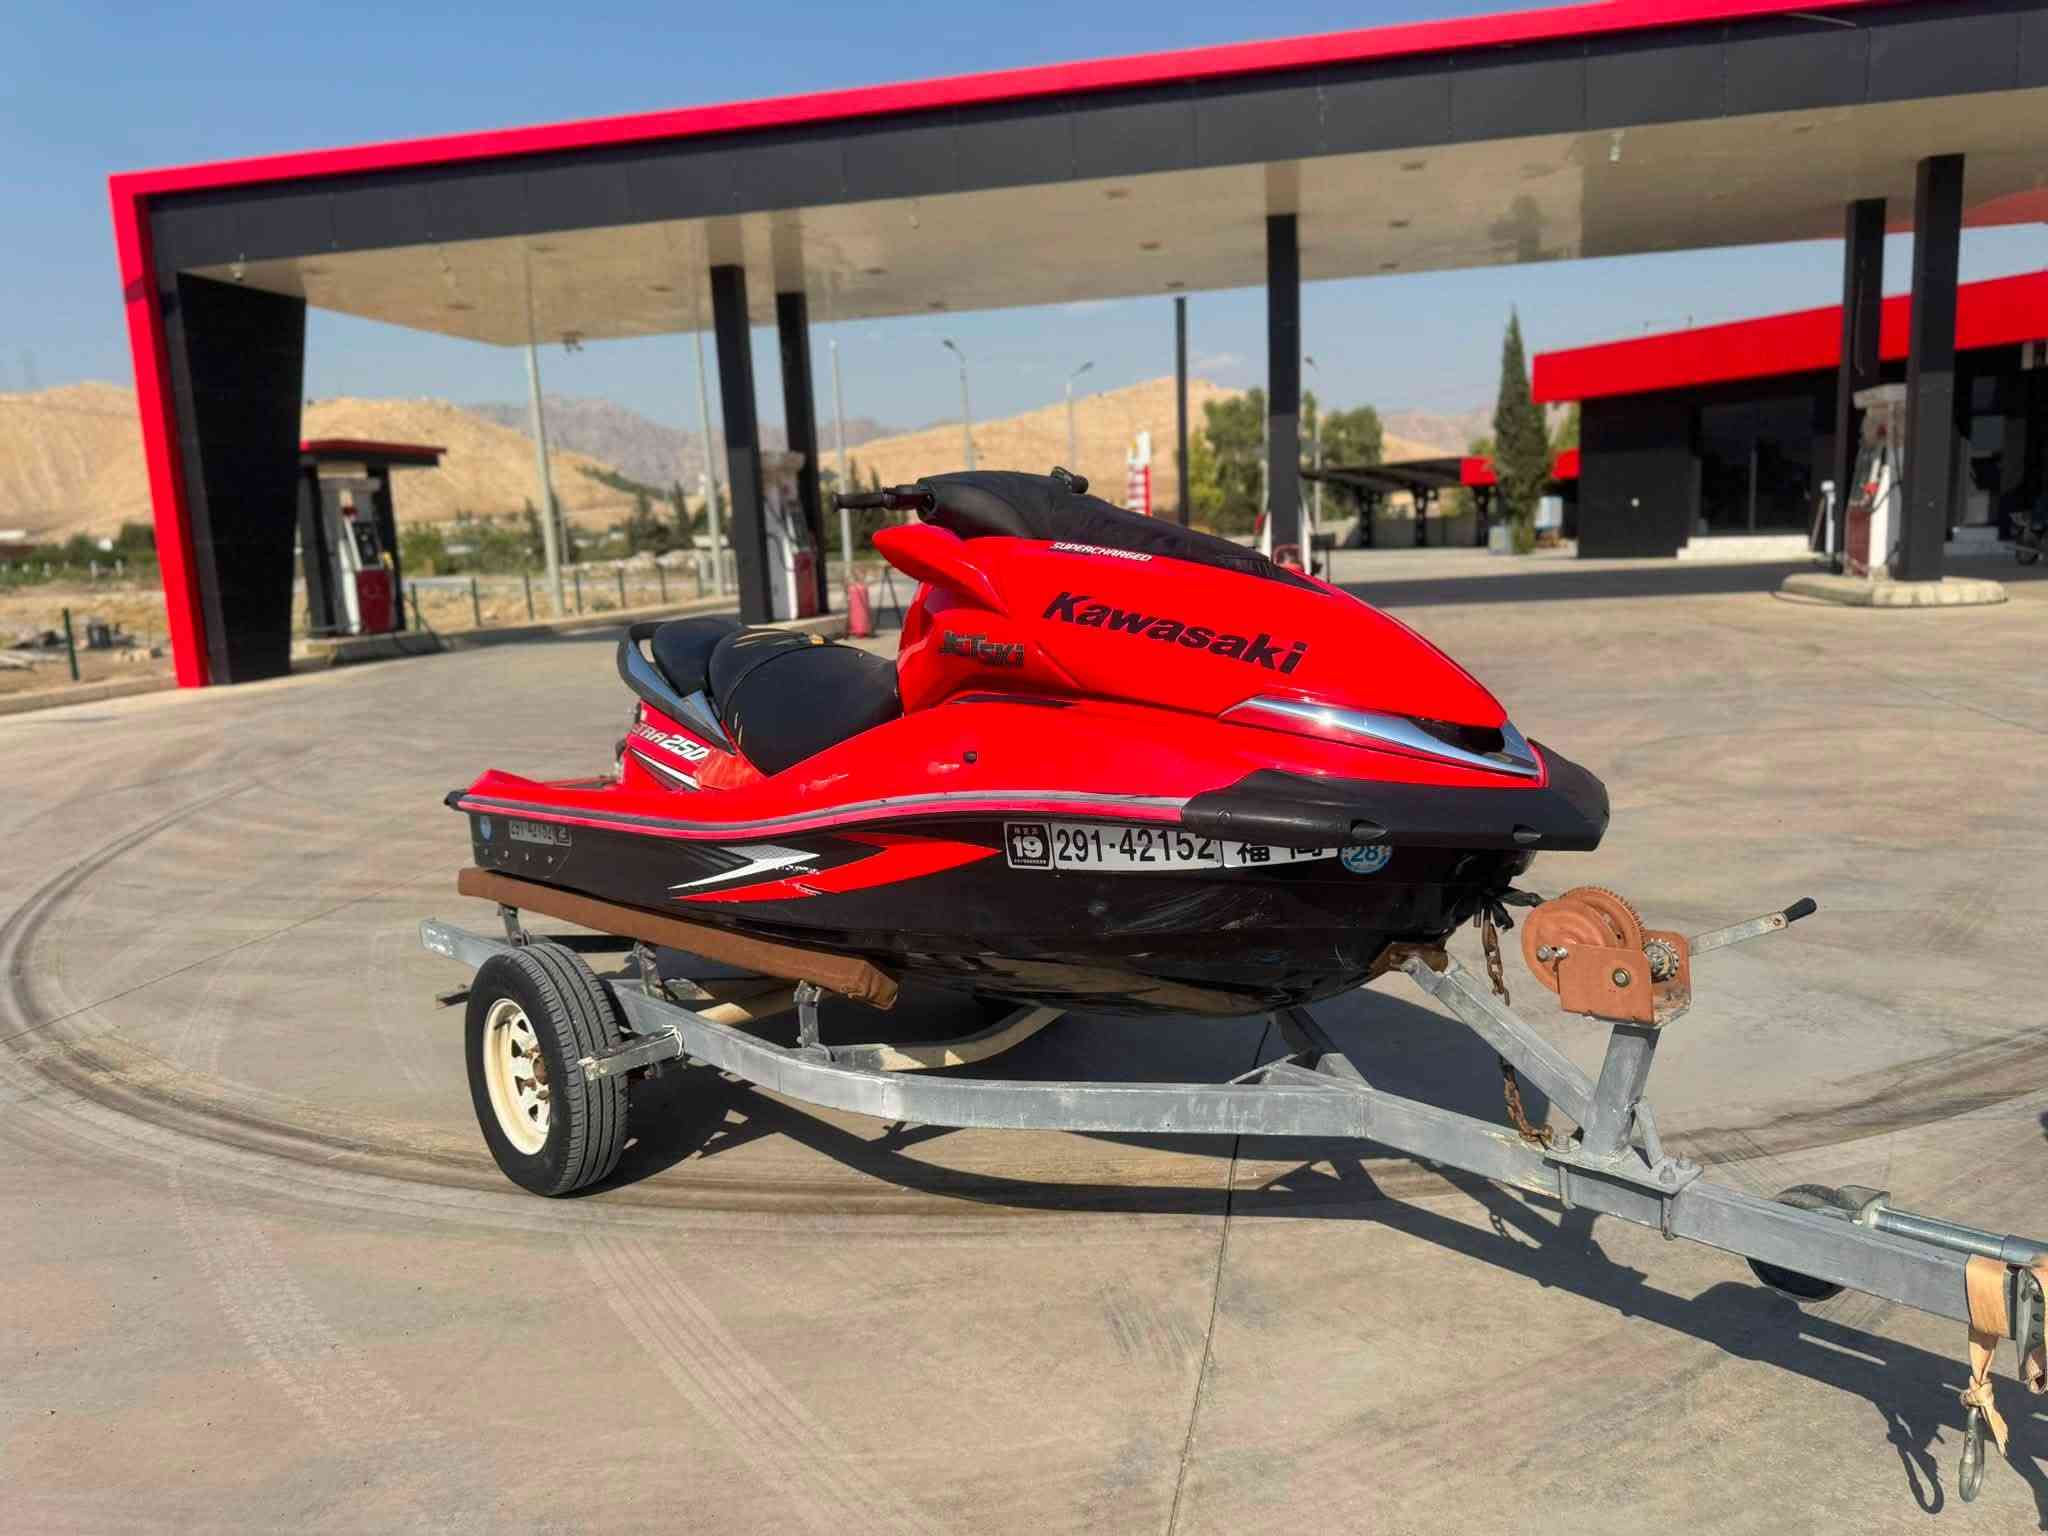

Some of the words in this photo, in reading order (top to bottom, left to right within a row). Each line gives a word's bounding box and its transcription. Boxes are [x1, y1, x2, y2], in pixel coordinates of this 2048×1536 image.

[1050, 542, 1153, 561] SUPERCHARGED
[1042, 592, 1308, 675] Kawasaki
[1012, 835, 1043, 858] 19
[1350, 845, 1379, 862] 28
